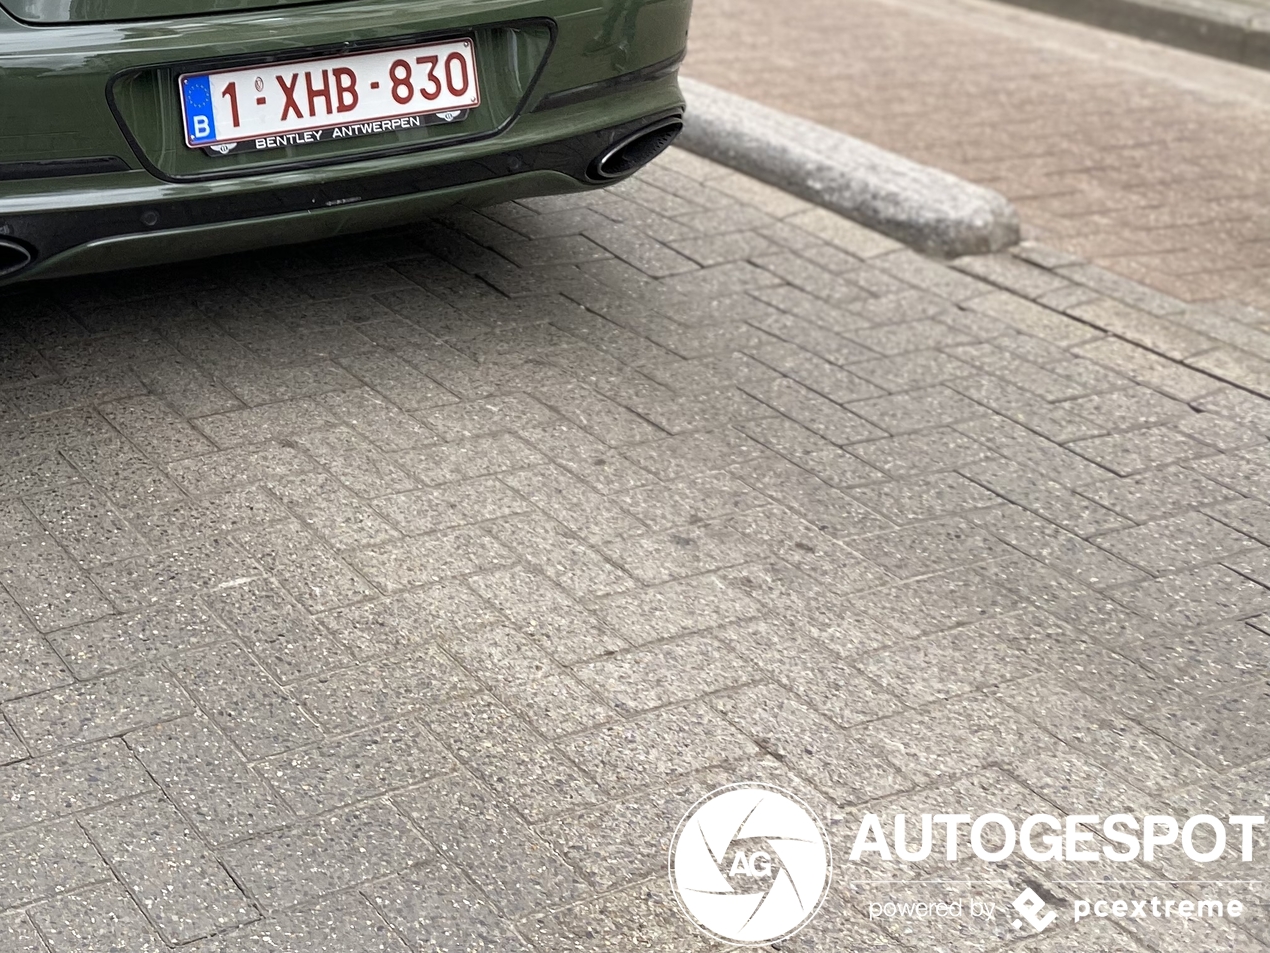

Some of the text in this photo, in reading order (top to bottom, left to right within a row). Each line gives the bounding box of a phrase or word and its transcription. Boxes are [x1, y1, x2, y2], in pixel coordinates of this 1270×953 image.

[221, 51, 470, 128] 1-XHB-830
[192, 114, 211, 138] B
[255, 115, 421, 150] BENTLEY ANTWERPEN
